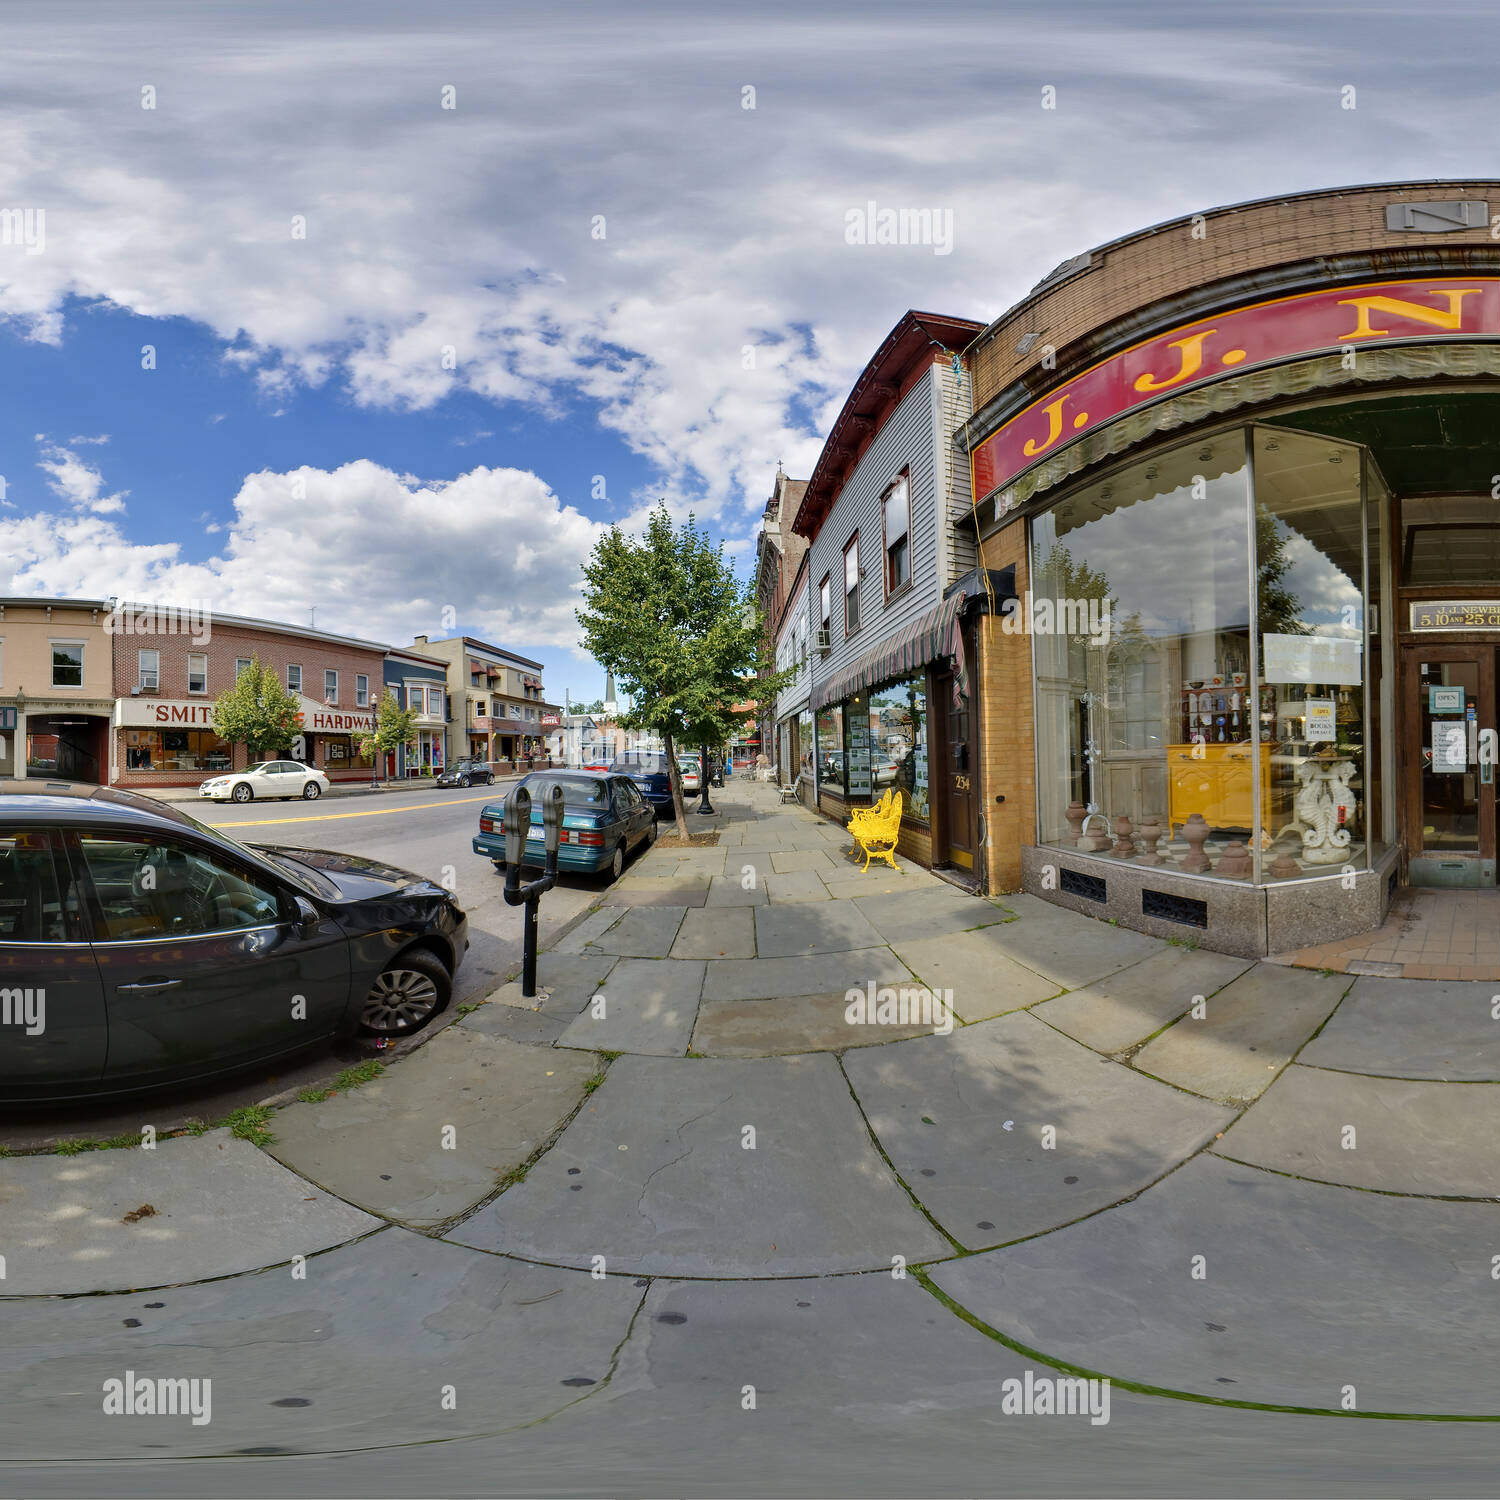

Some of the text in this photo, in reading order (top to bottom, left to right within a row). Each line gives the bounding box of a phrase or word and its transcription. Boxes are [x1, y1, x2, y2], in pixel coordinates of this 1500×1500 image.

[1023, 394, 1089, 457] J.
[1133, 329, 1246, 392] J.
[1464, 613, 1485, 625] 25
[156, 705, 217, 724] SMIT
